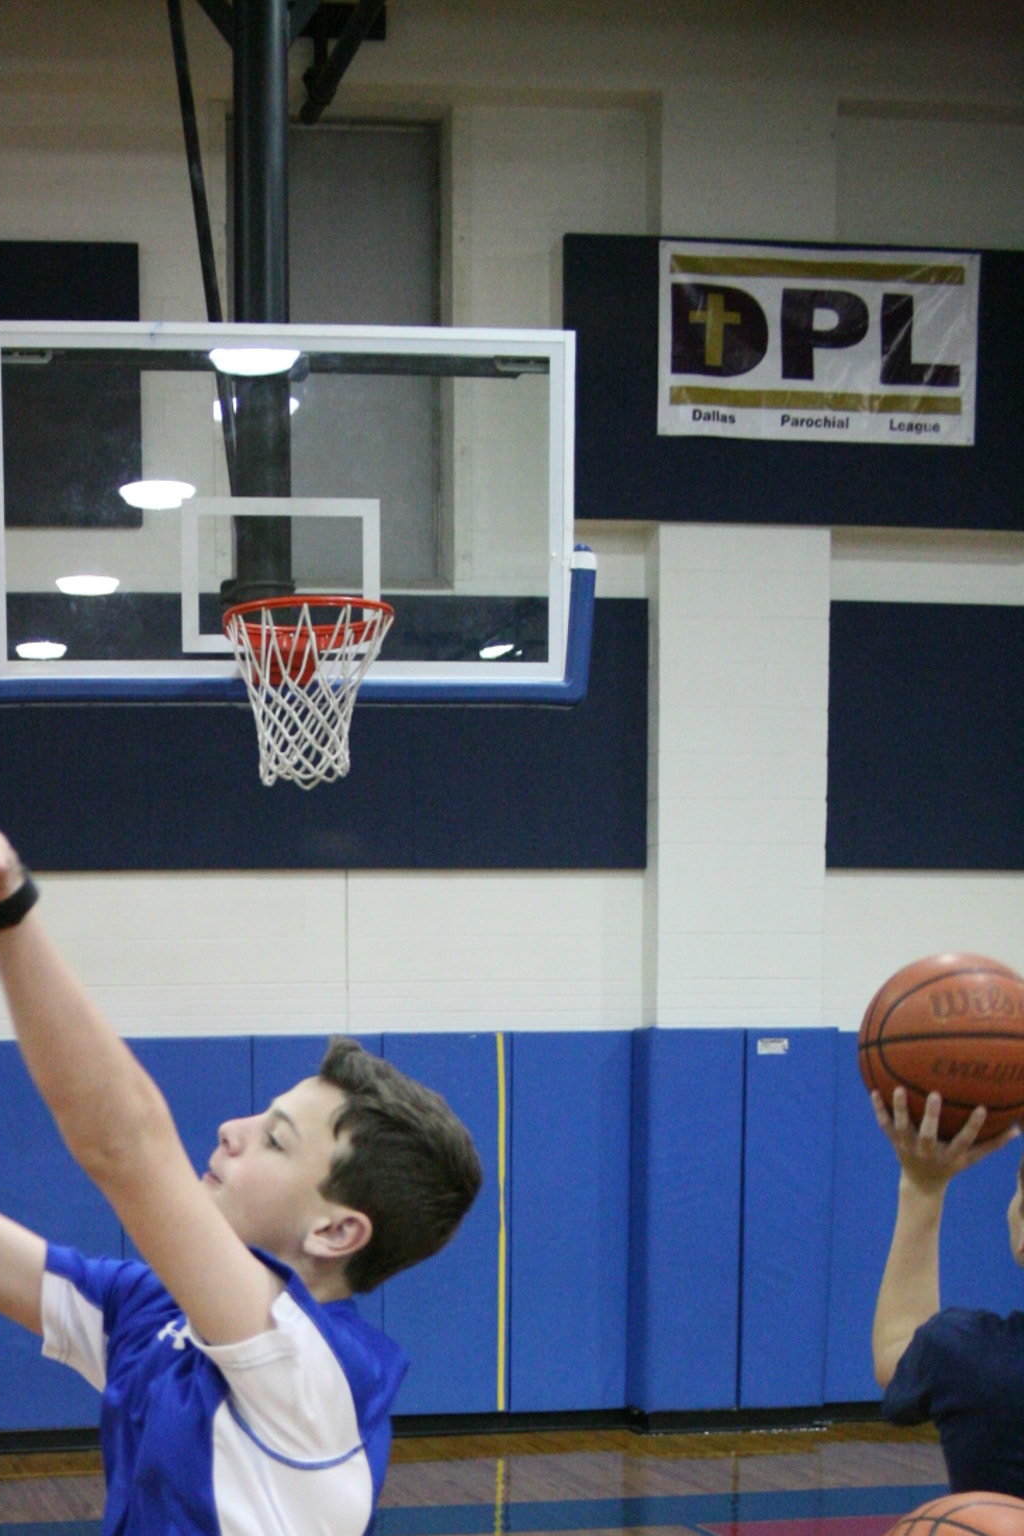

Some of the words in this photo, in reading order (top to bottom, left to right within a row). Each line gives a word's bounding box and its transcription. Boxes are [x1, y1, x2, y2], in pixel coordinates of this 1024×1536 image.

[671, 282, 960, 387] DPL
[692, 409, 736, 424] Dallas
[781, 414, 849, 429] Parochial
[890, 419, 940, 434] League
